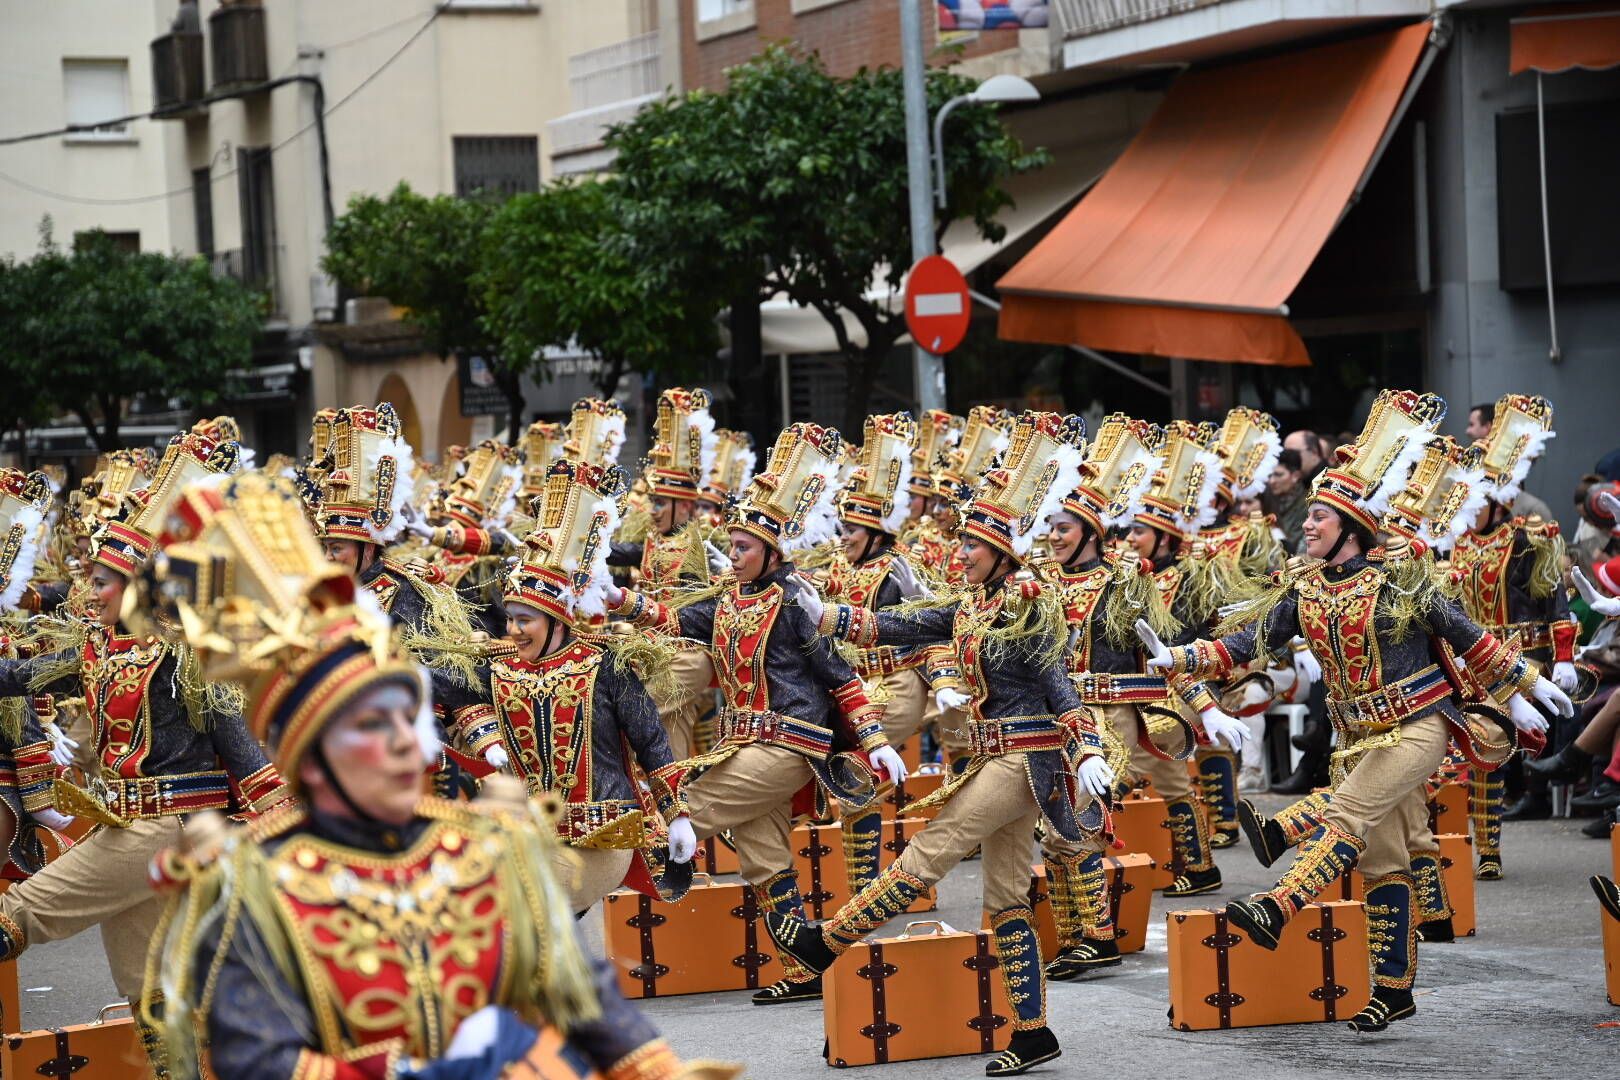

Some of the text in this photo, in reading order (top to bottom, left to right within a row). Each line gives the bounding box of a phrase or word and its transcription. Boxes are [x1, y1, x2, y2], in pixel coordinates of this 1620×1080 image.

[1413, 401, 1435, 420] 21
[1529, 403, 1542, 416] 21
[896, 422, 908, 434] 21
[1058, 425, 1077, 443] 21
[1197, 428, 1210, 443] 21
[208, 451, 233, 472] 21
[690, 431, 698, 475] HOTEL
[377, 461, 391, 522] HOTEL
[1111, 464, 1142, 514] HOTEL
[1185, 465, 1202, 516] HOTEL
[788, 478, 819, 533] HOTEL
[1434, 485, 1466, 533] HOTEL
